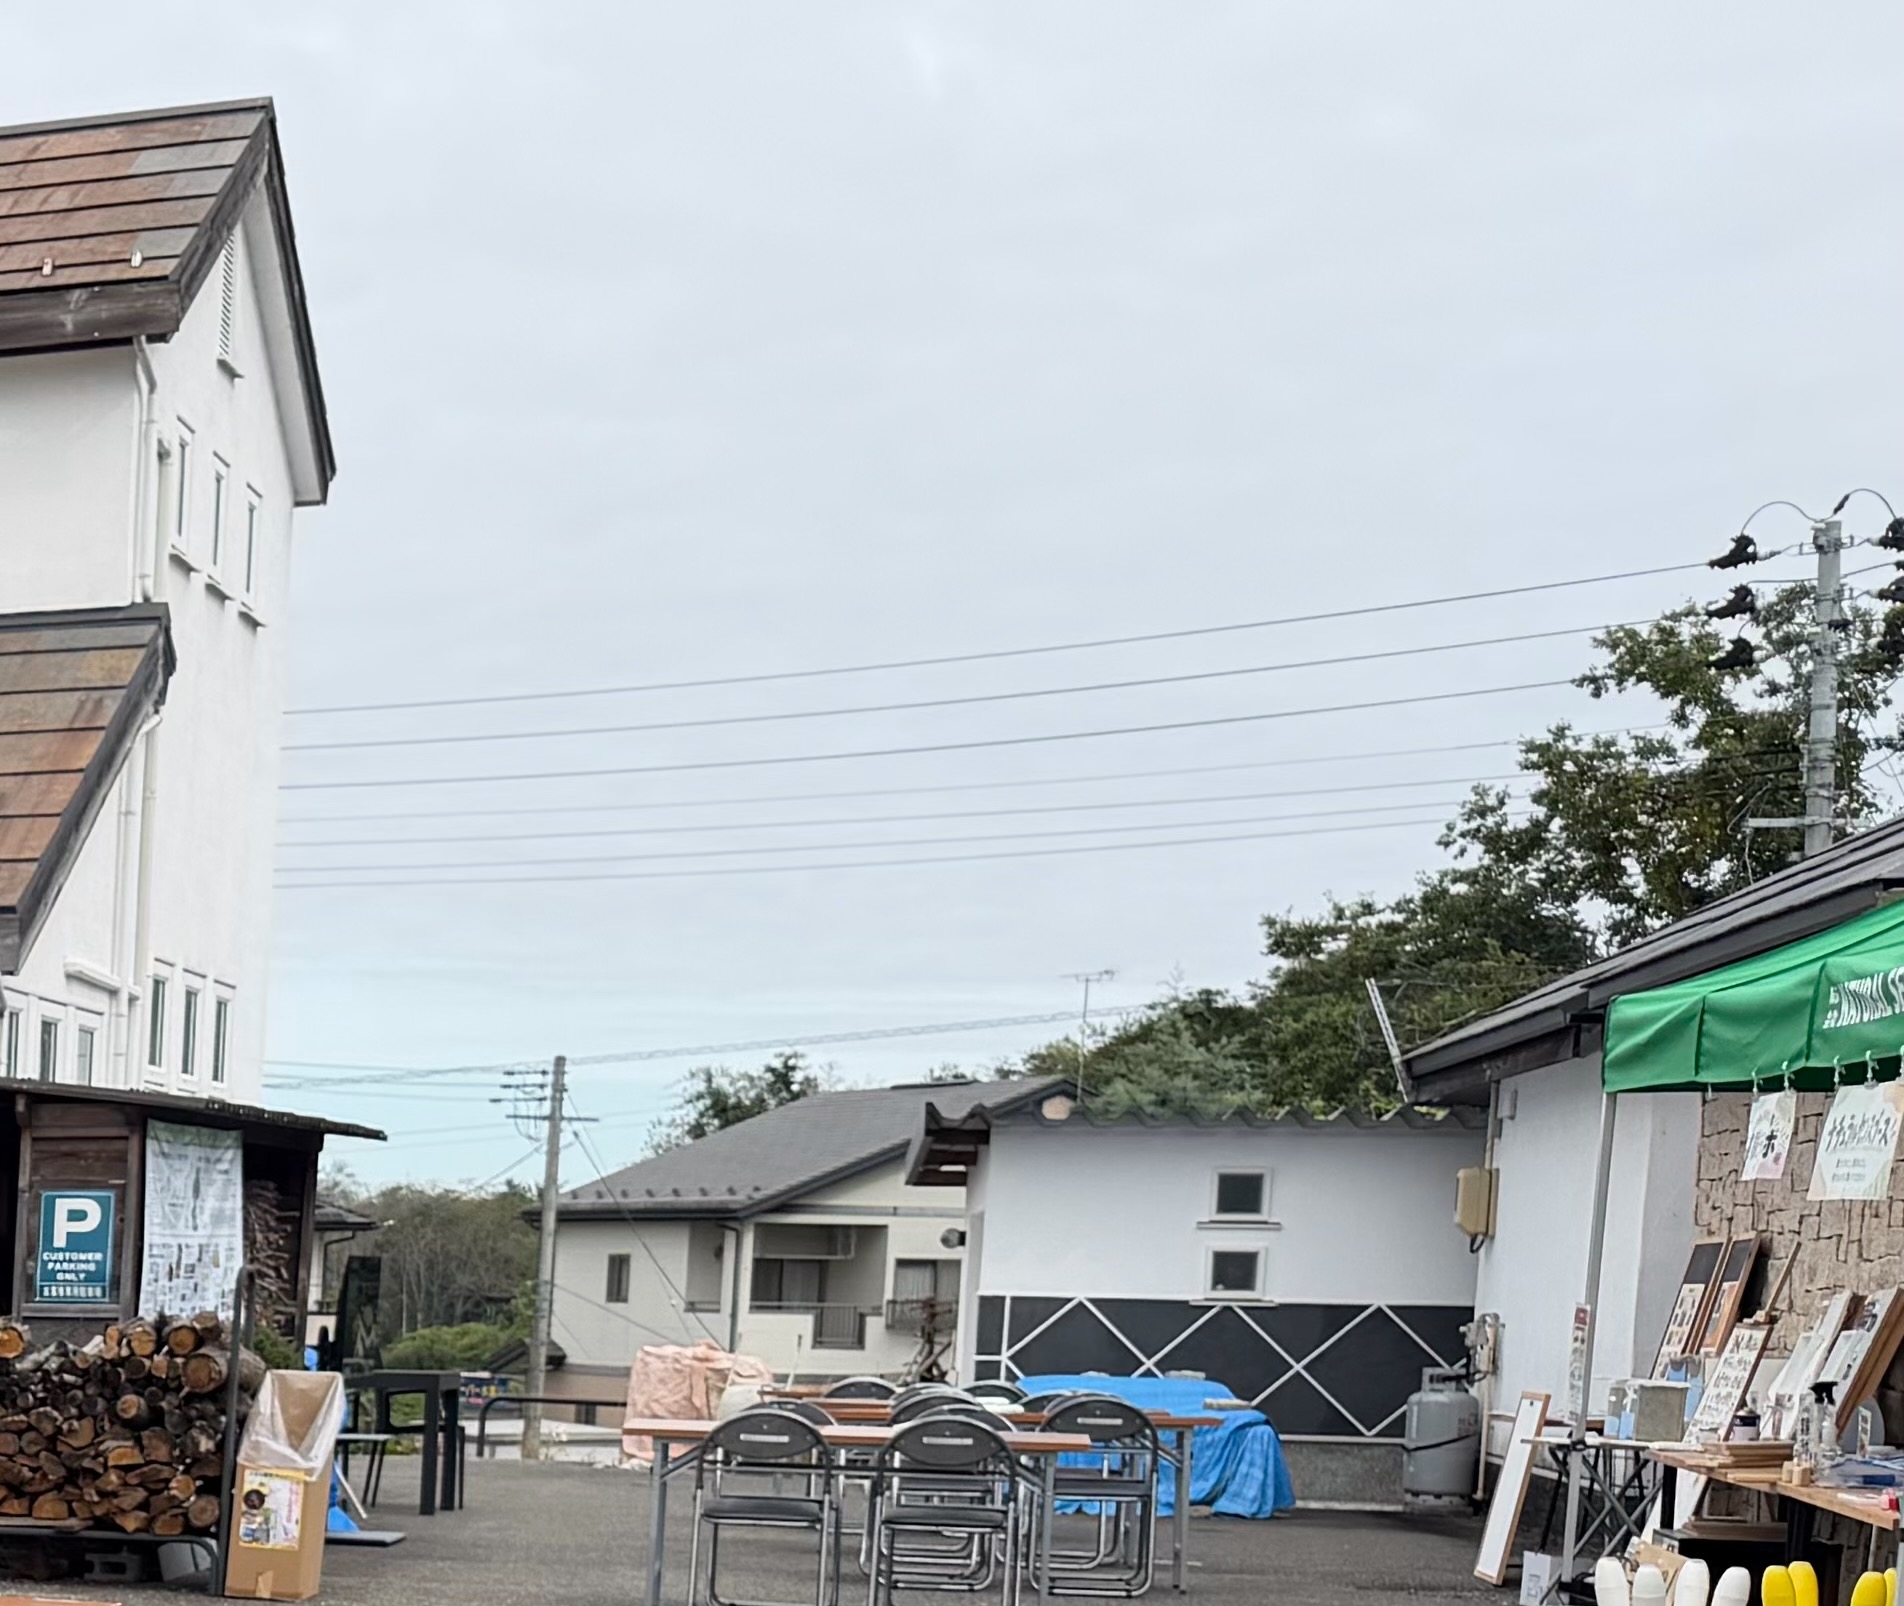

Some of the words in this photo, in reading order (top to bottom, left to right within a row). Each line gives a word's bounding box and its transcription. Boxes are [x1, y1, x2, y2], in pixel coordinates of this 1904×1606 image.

[53, 1198, 102, 1249] P
[42, 1251, 104, 1261] CUSTOMER
[47, 1261, 97, 1272] PARKING
[56, 1271, 86, 1281] ONLY
